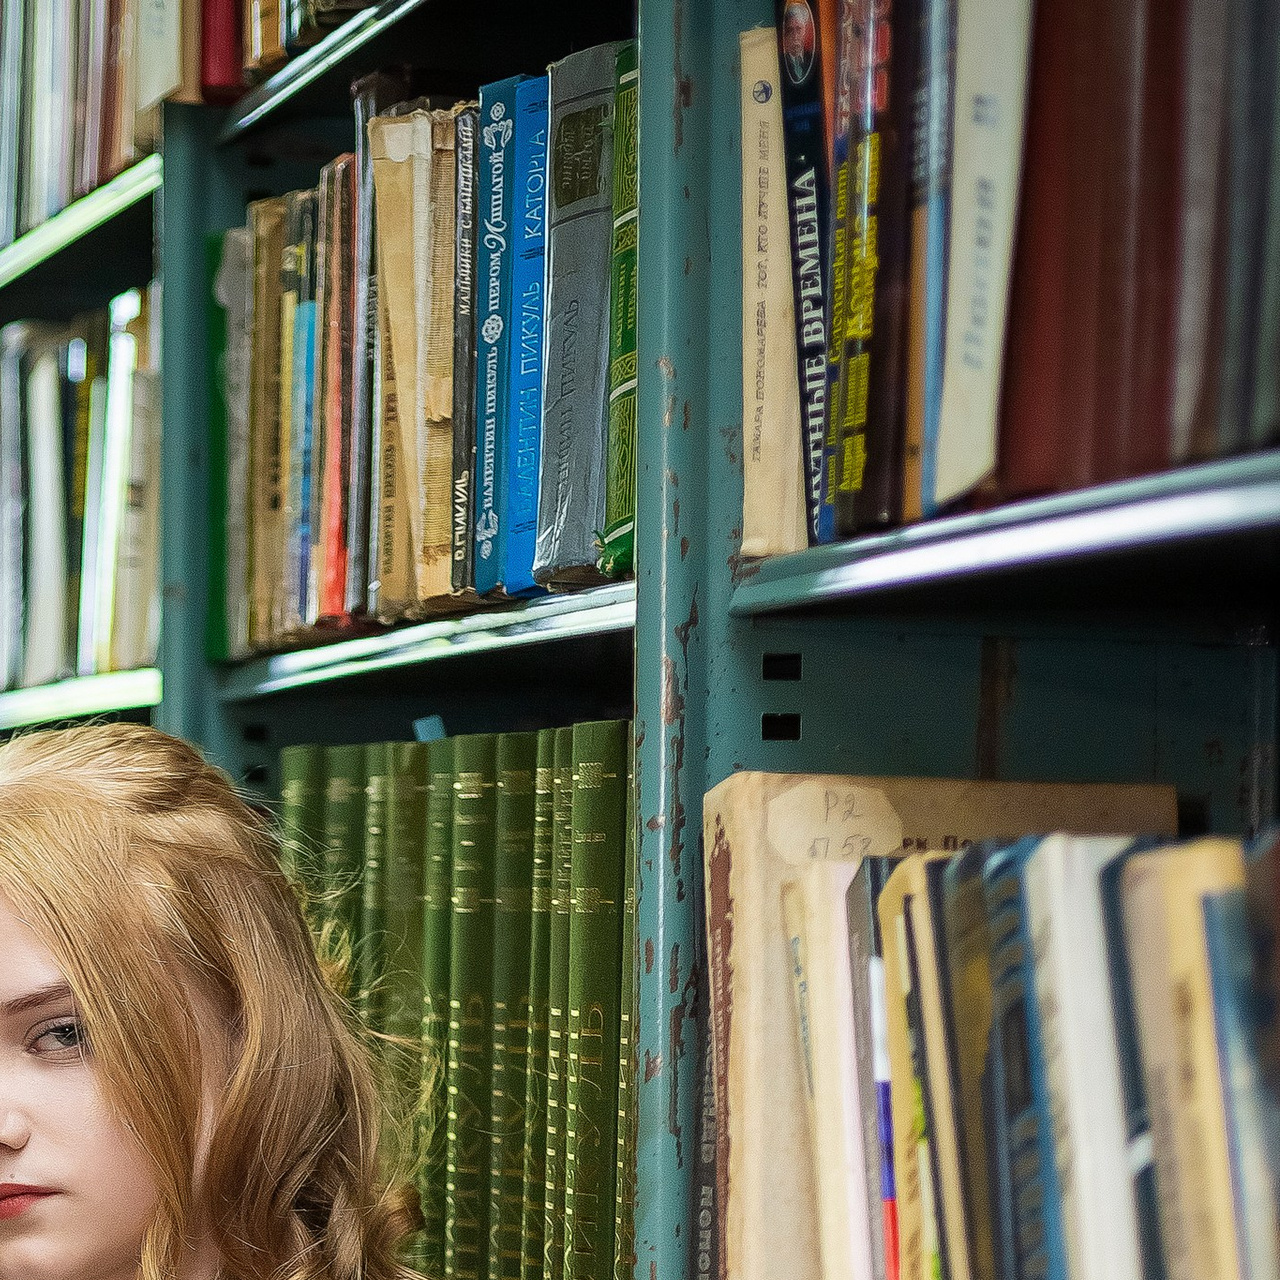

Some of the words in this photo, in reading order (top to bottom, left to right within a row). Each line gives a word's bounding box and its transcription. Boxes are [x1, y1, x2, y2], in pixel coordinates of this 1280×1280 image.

[523, 127, 545, 240] КАТОРГА
[758, 119, 771, 162] МЕНЯ
[457, 237, 473, 317] МАЛЬЧИКИ
[757, 227, 770, 254] КТО
[789, 167, 824, 349] ВРЕМЕНА
[519, 279, 541, 376] ПИКУЛЬ
[482, 346, 500, 415] ПИКУЛЬ
[480, 417, 498, 510] ВАЛЕНТИН
[516, 387, 539, 515] ВАЛЕНТИН
